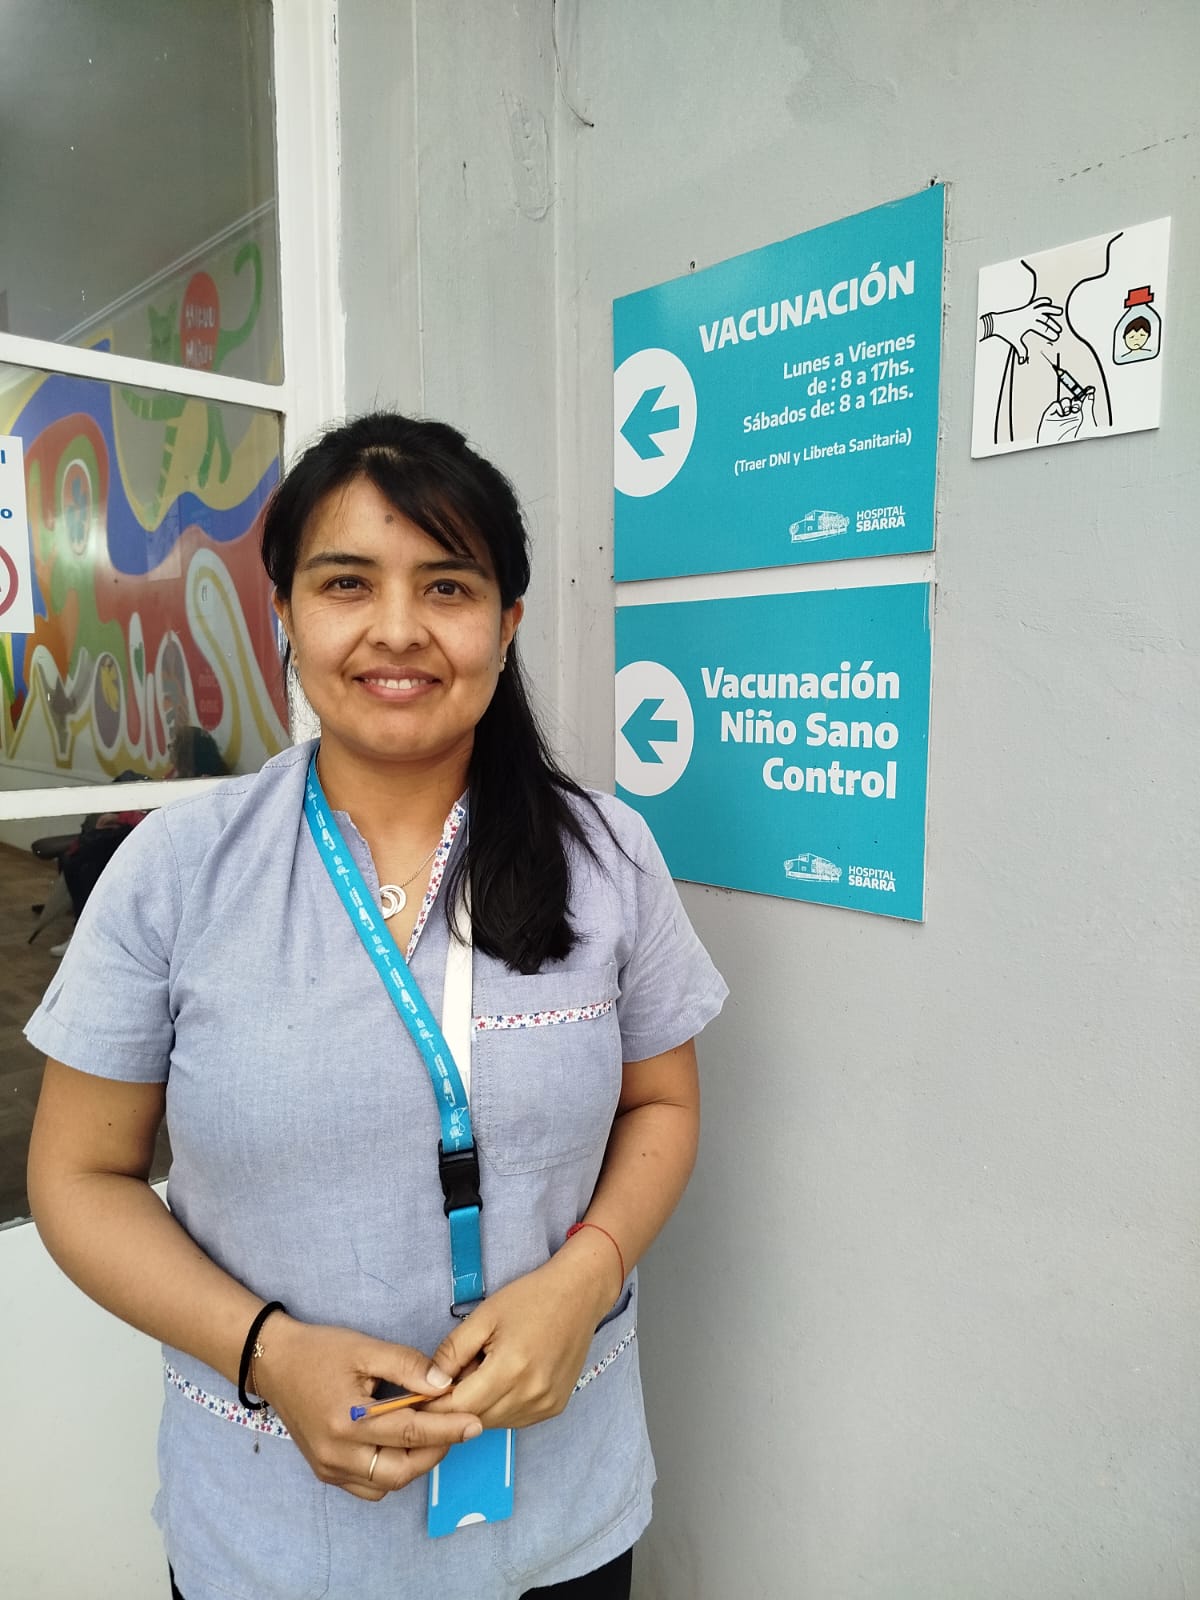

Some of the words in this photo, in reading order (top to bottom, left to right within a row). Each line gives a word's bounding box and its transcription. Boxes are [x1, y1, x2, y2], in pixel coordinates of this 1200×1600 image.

[699, 261, 915, 353] VACUNACIÓN
[784, 356, 831, 380] Lunes
[835, 353, 844, 367] a
[849, 333, 916, 362] Viernes
[808, 376, 827, 396] de
[841, 371, 852, 388] 8
[857, 371, 866, 385] a
[871, 359, 914, 382] 17hs.
[743, 406, 807, 433] Sábados
[810, 400, 835, 419] de:
[840, 394, 851, 412] 8
[856, 395, 865, 410] a
[870, 383, 914, 406] 12hs.
[734, 455, 767, 476] (Traer
[769, 450, 791, 468] DNI
[793, 452, 801, 466] y
[803, 441, 847, 463] Libreta
[849, 427, 912, 453] Sanitaria)
[856, 505, 906, 520] HOSPITAL
[856, 515, 906, 533] SBARRA
[701, 660, 900, 700] Vacunación
[721, 708, 797, 745] Niño
[806, 712, 899, 750] Sano
[762, 757, 897, 799] Control
[848, 865, 896, 881] HOSPITAL
[848, 876, 896, 892] SBARRA
